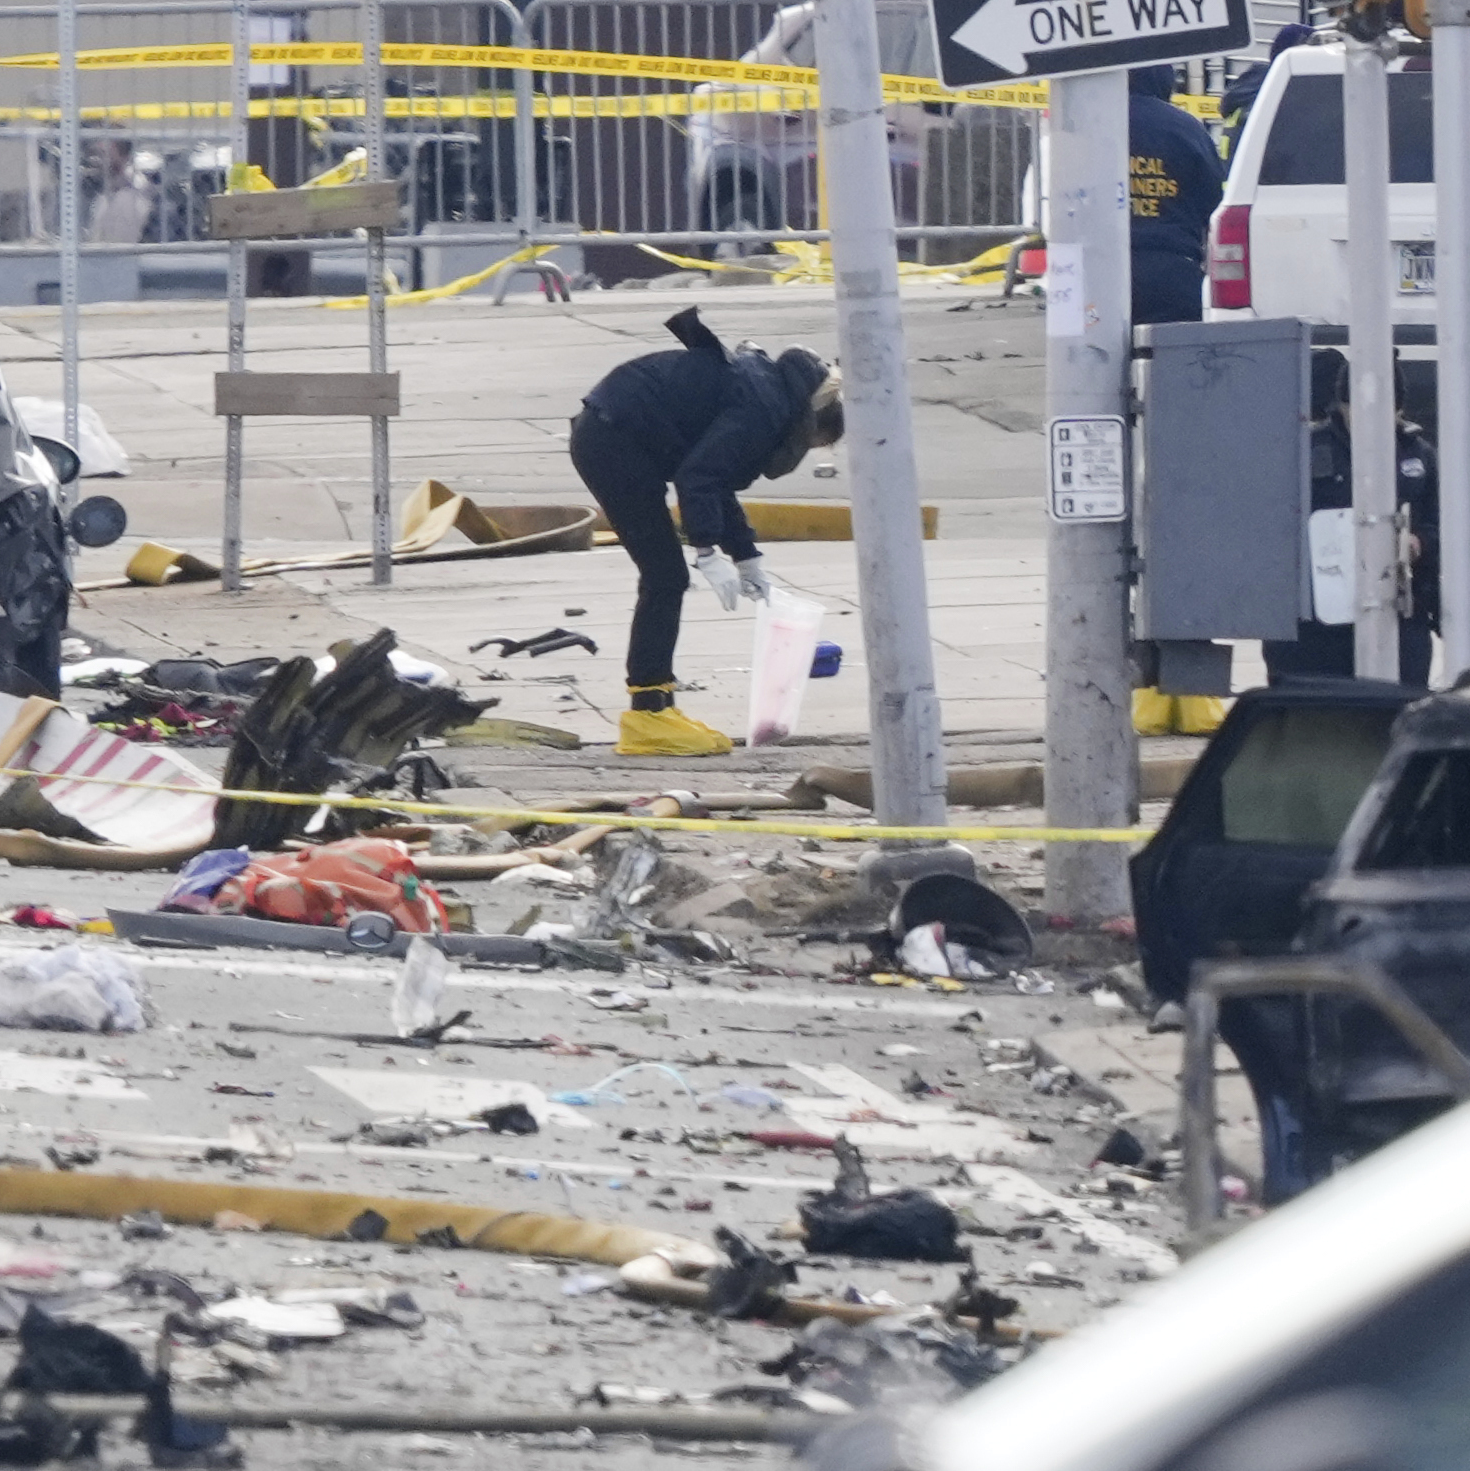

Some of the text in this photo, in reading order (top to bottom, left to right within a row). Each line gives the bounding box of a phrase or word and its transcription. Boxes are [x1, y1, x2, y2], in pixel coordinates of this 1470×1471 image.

[1029, 0, 1111, 45] ONE
[1130, 178, 1178, 198] INERS
[1130, 198, 1160, 217] ICE
